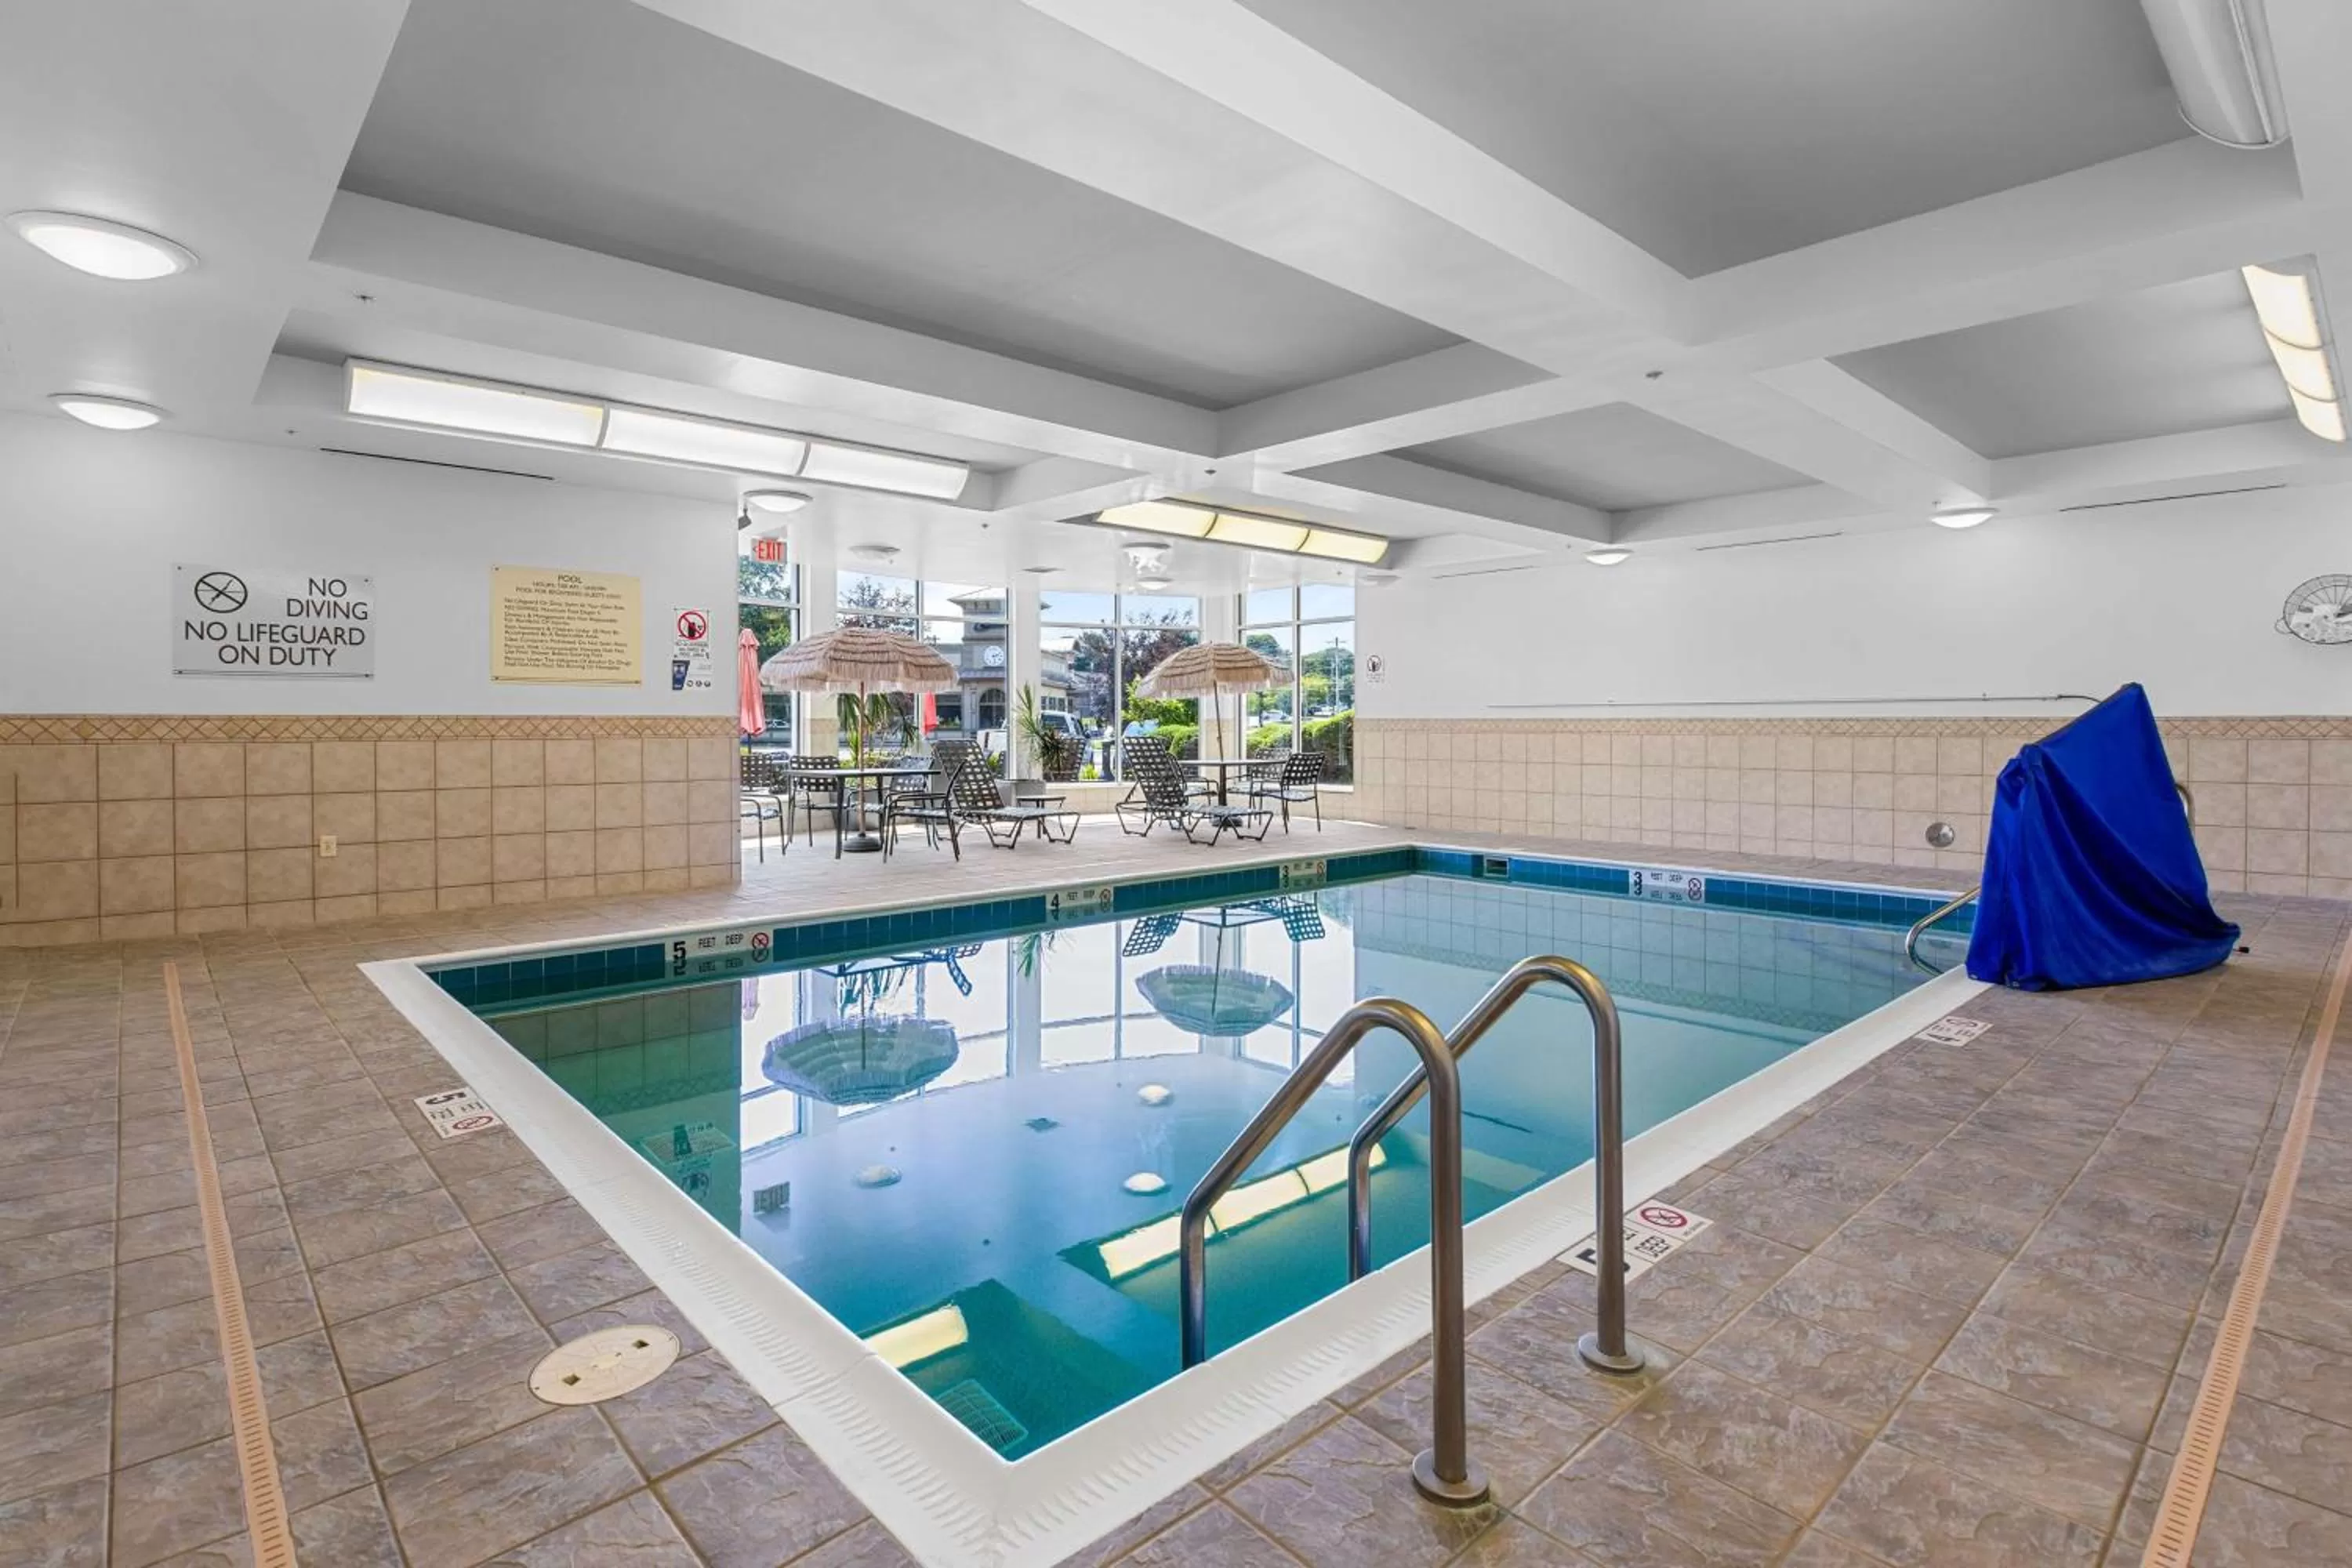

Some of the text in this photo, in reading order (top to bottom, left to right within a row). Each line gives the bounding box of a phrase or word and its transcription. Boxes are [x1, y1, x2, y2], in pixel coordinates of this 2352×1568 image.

[758, 539, 783, 561] EXIT
[308, 577, 347, 597] NO
[557, 574, 583, 583] POOL
[286, 598, 368, 620] DIVING
[184, 620, 365, 645] NO LIFEGUARD
[218, 644, 336, 666] ON DUTY
[1051, 893, 1060, 908] 4
[673, 933, 744, 960] 5 FEET DEEP
